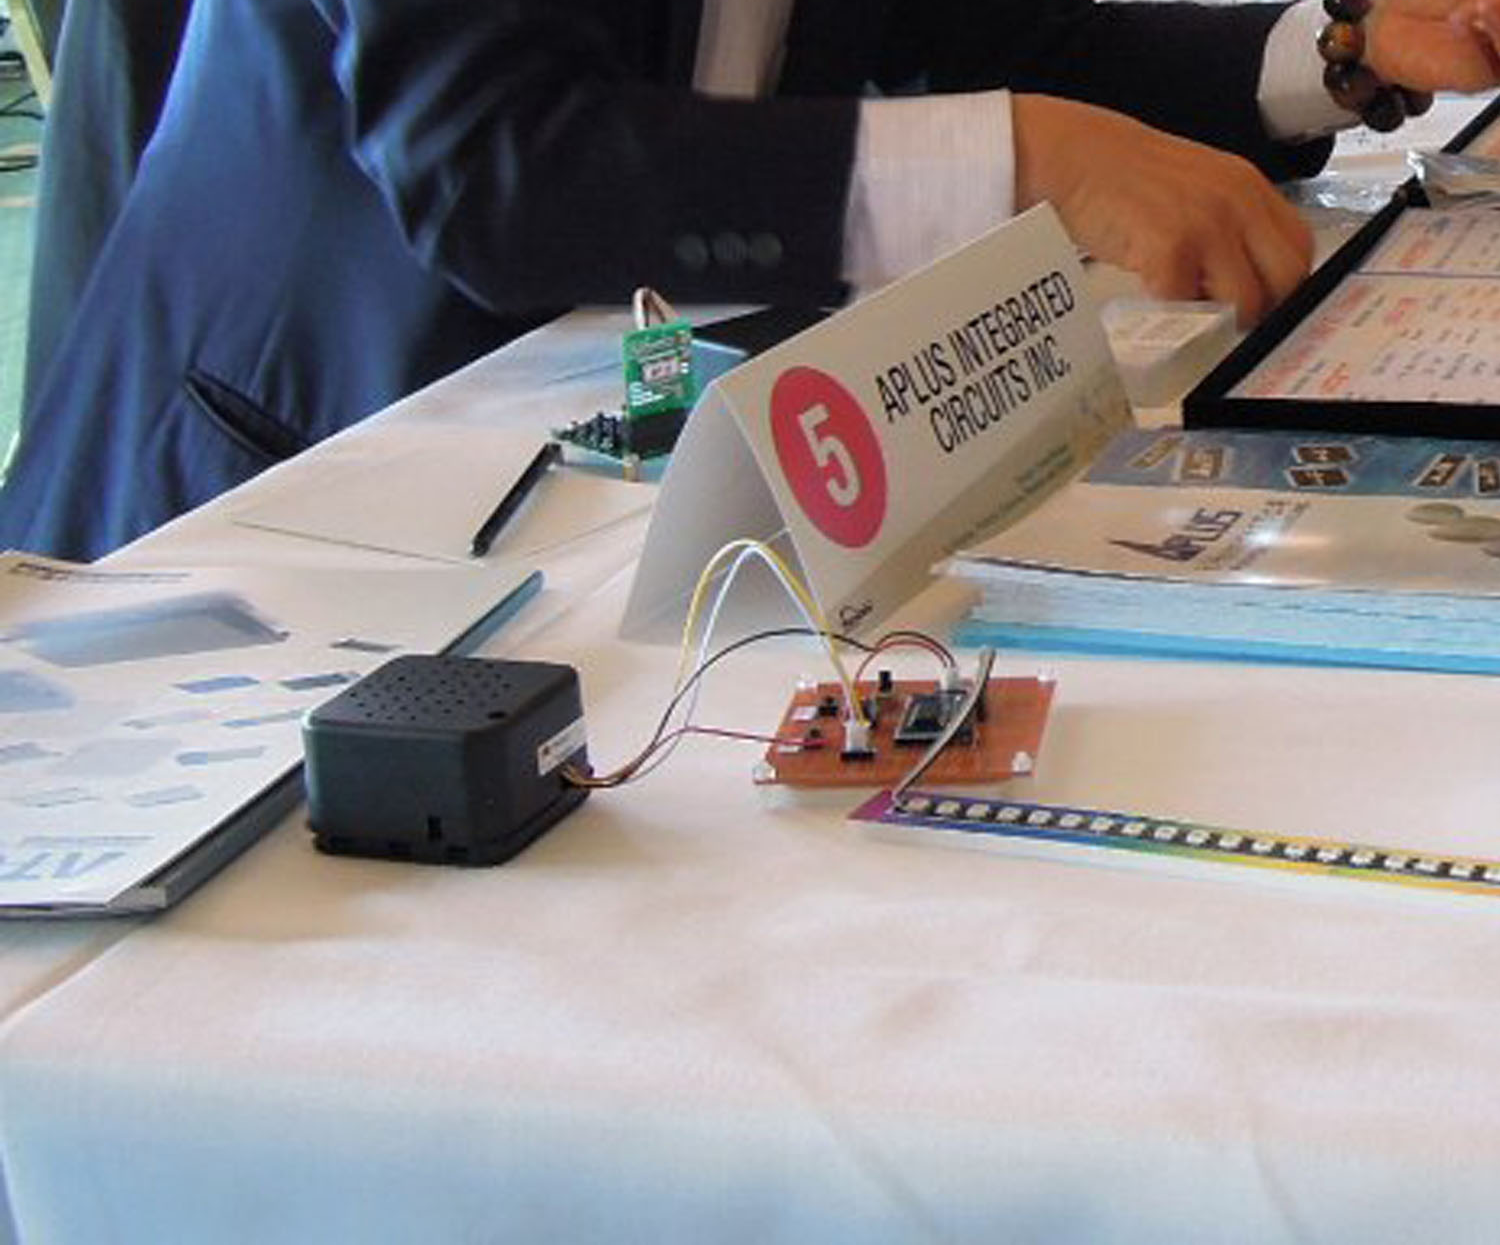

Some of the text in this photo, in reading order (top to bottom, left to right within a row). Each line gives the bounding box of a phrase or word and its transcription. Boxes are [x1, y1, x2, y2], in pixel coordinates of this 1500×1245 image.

[875, 270, 1075, 424] APLUS INTEGRATED
[929, 335, 1072, 453] CIRCUITS INC.
[797, 402, 862, 507] 5
